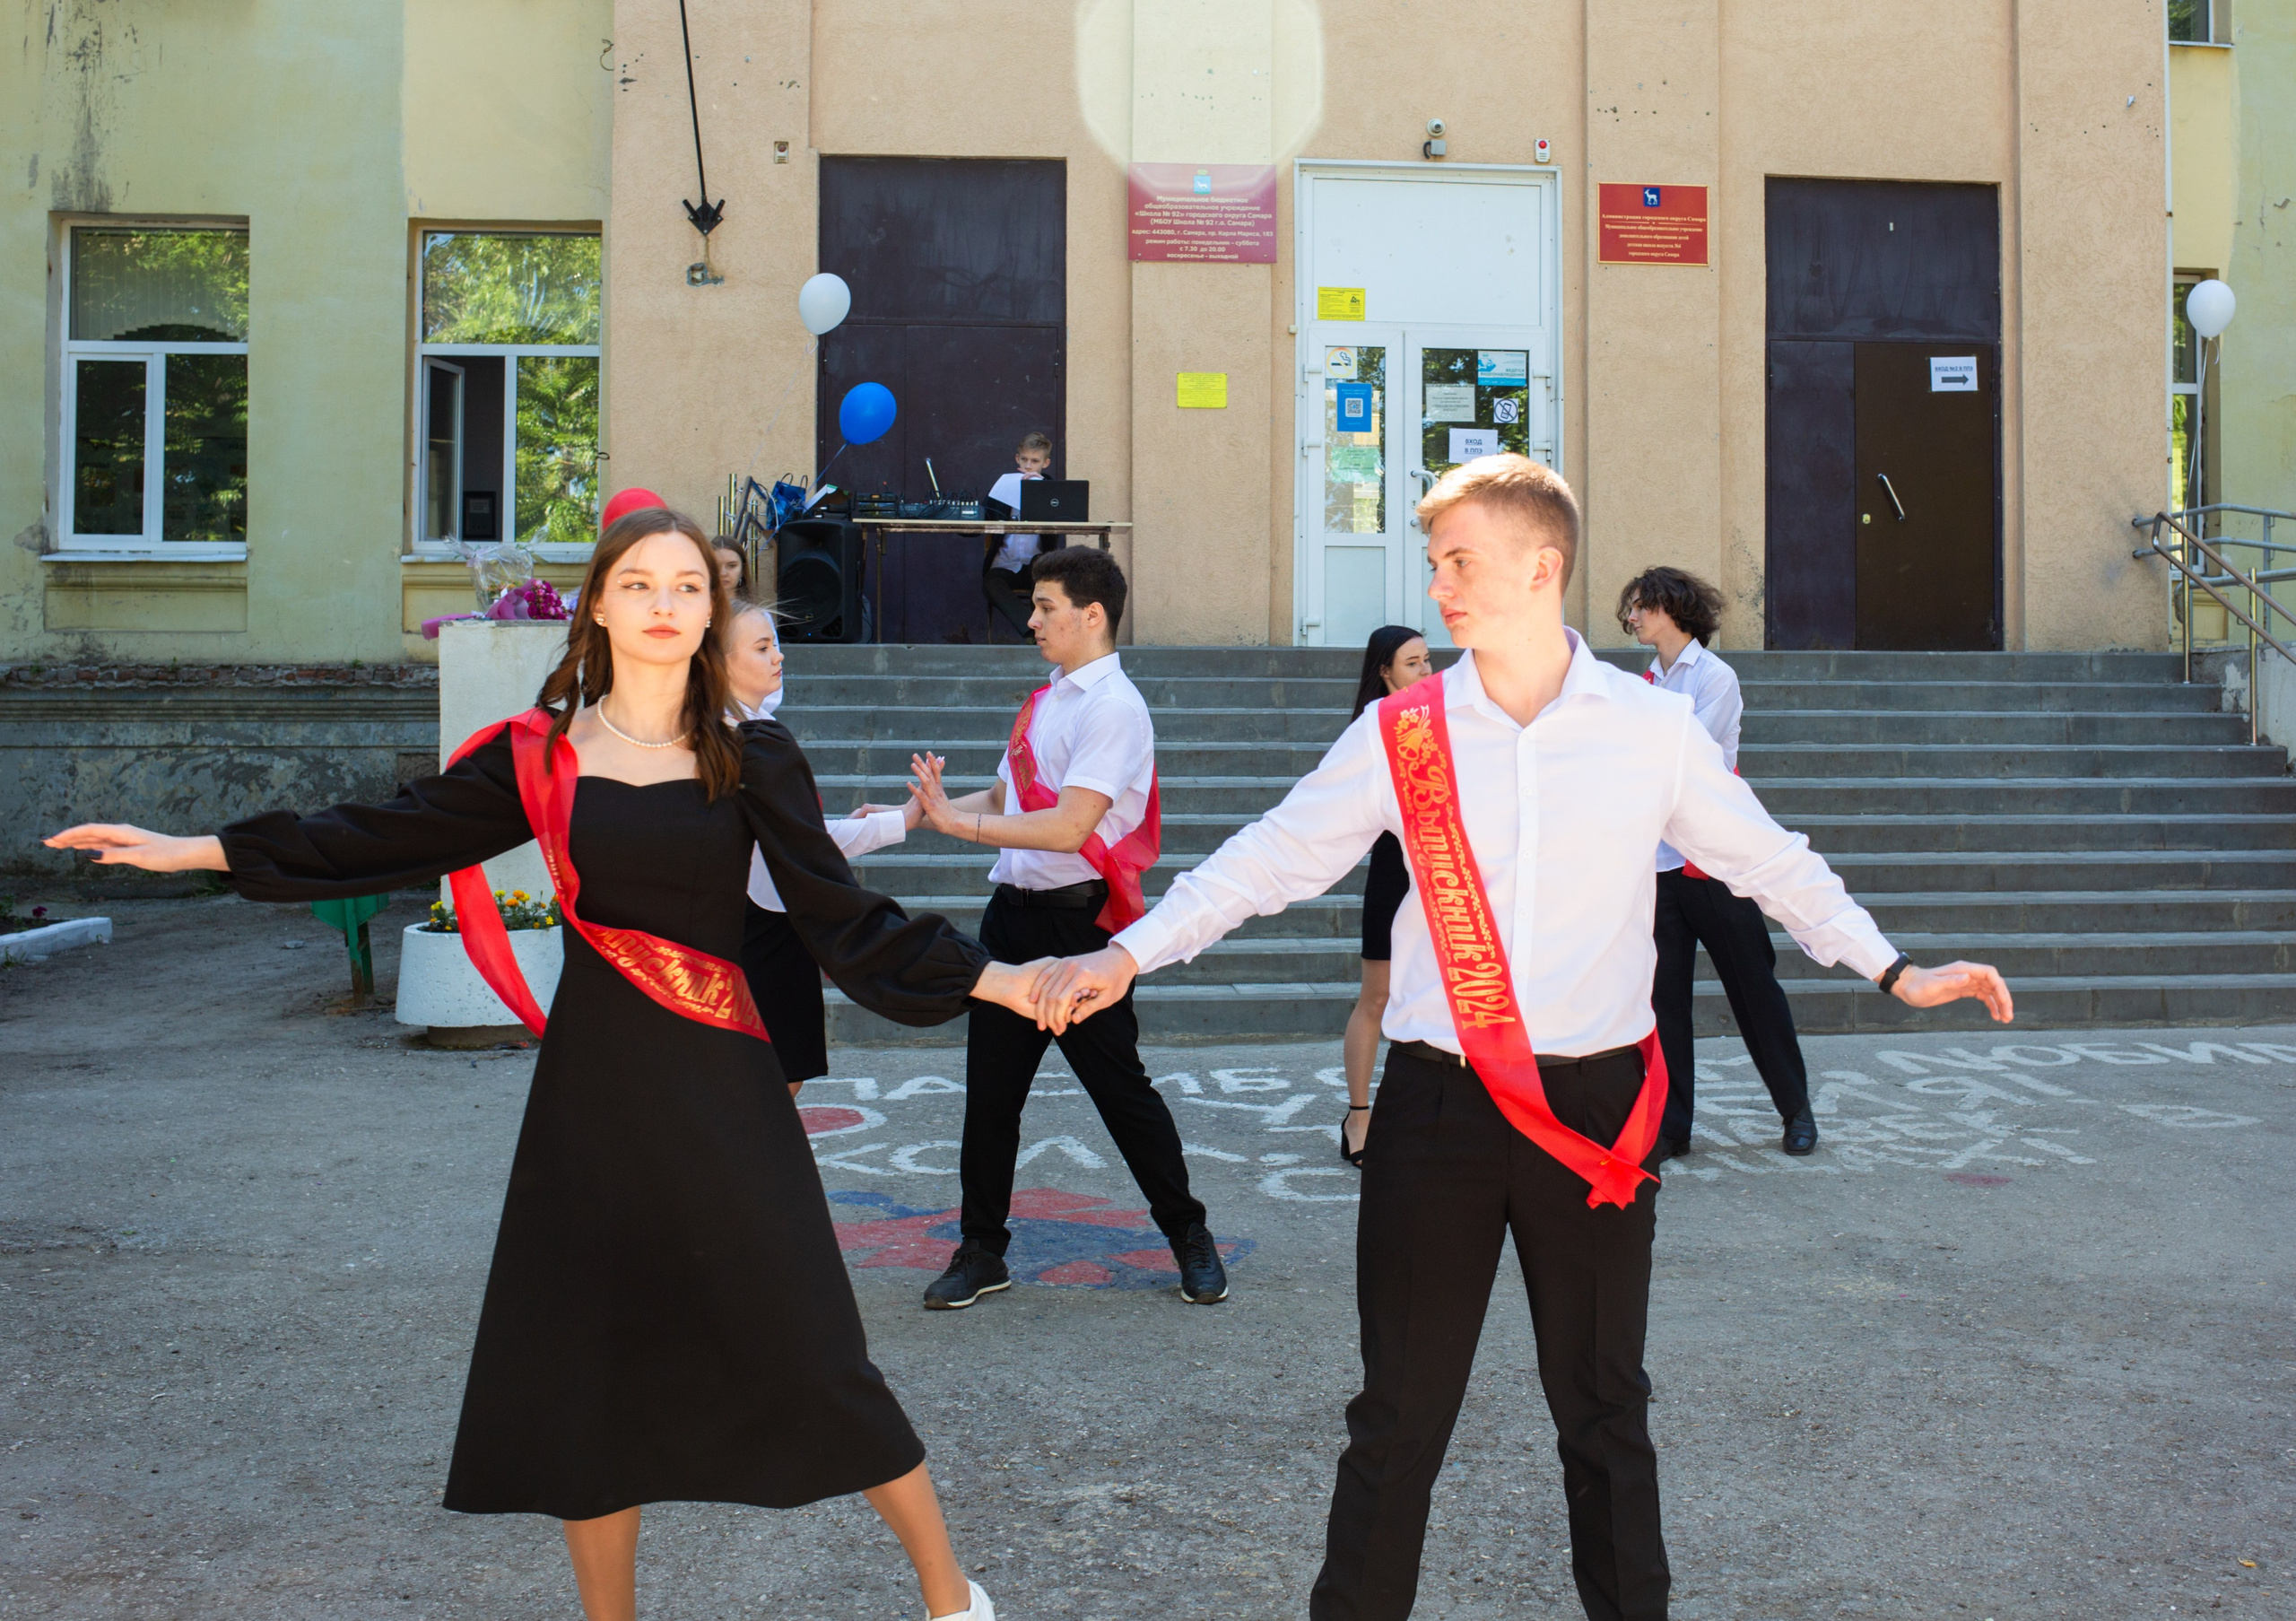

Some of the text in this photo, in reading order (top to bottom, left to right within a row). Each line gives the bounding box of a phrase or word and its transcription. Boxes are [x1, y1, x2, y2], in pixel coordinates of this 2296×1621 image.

[1157, 196, 1209, 204] Муниципальное
[1144, 203, 1219, 211] общеобразовательное
[1406, 759, 1517, 1031] Выпускник 2024
